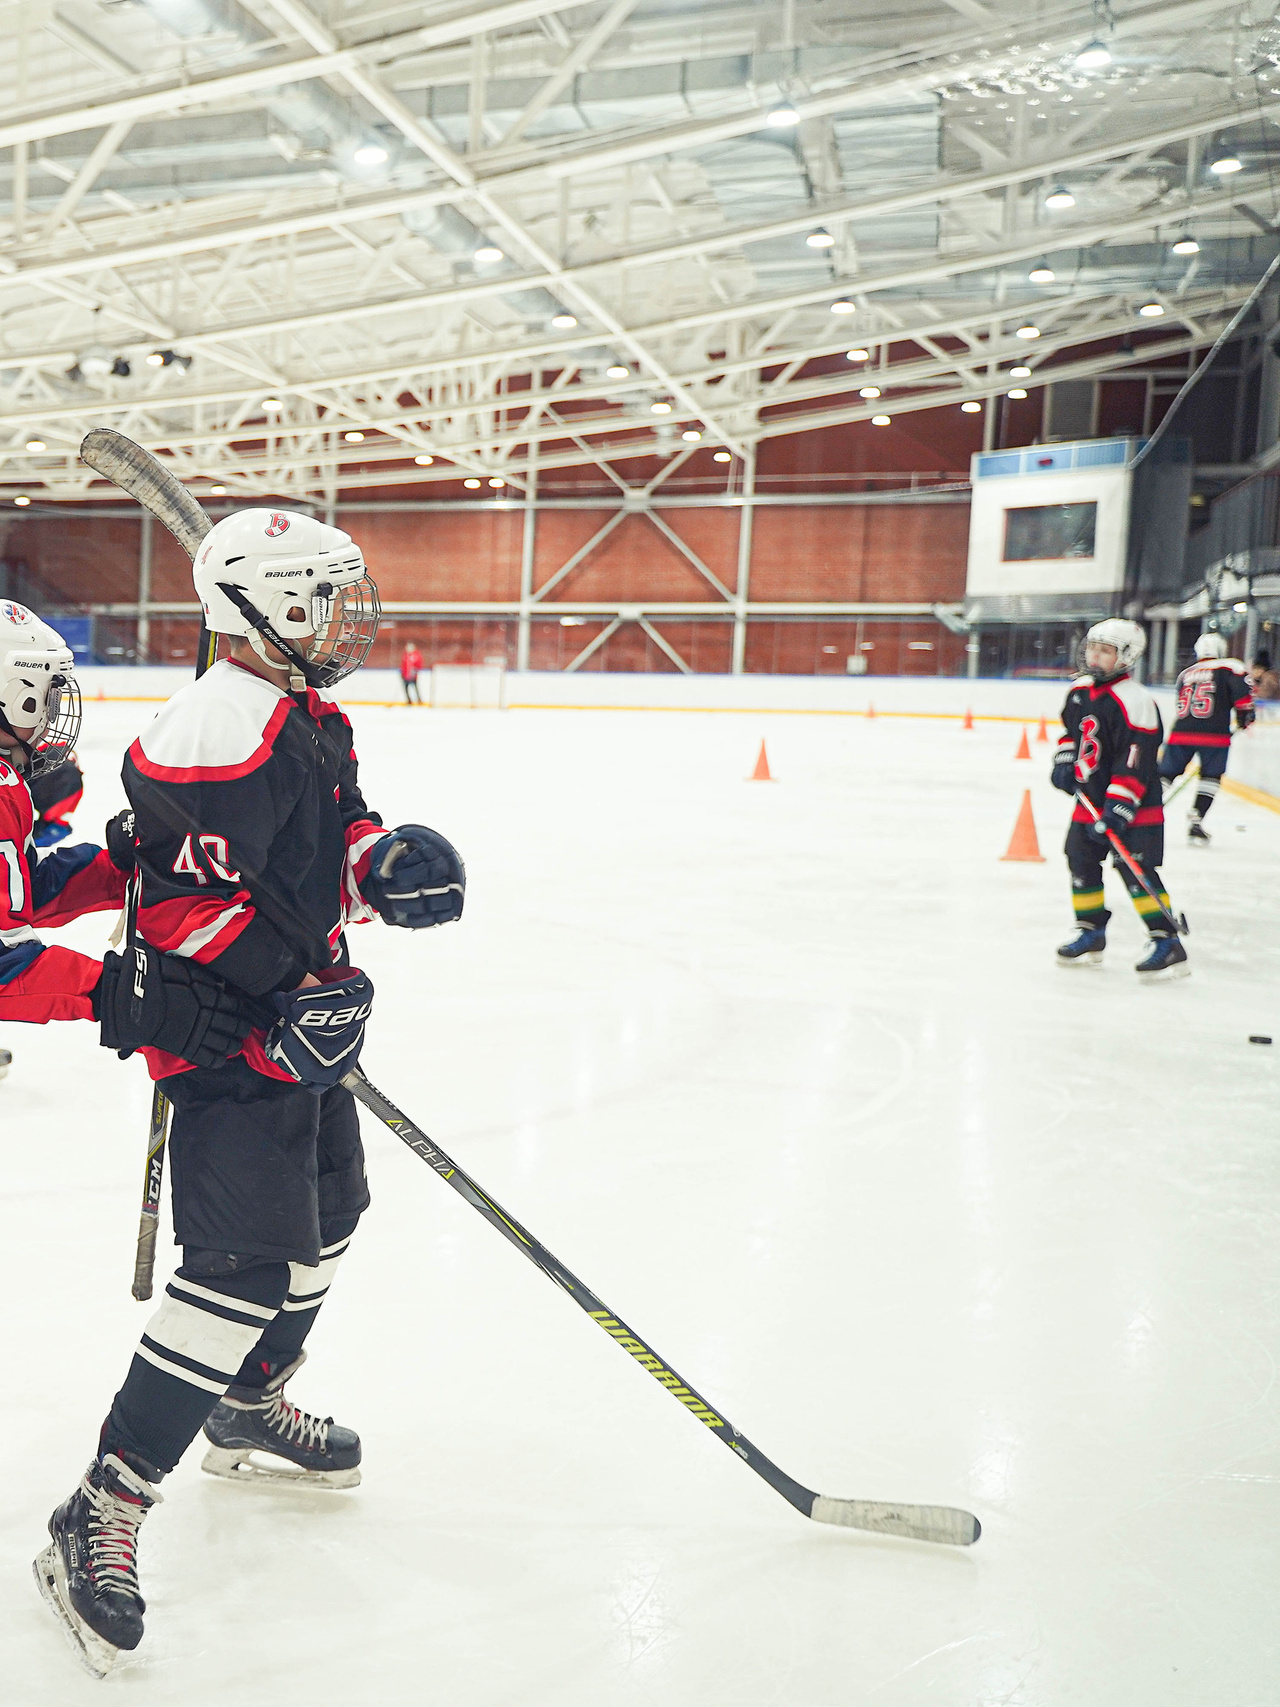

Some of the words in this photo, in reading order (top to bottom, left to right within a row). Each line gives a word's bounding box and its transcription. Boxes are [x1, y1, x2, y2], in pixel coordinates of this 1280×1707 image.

[263, 627, 294, 656] BAUER
[172, 832, 242, 888] 40
[386, 1118, 455, 1180] ALPHA
[148, 1157, 162, 1205] CM
[587, 1310, 725, 1428] WARRIOR
